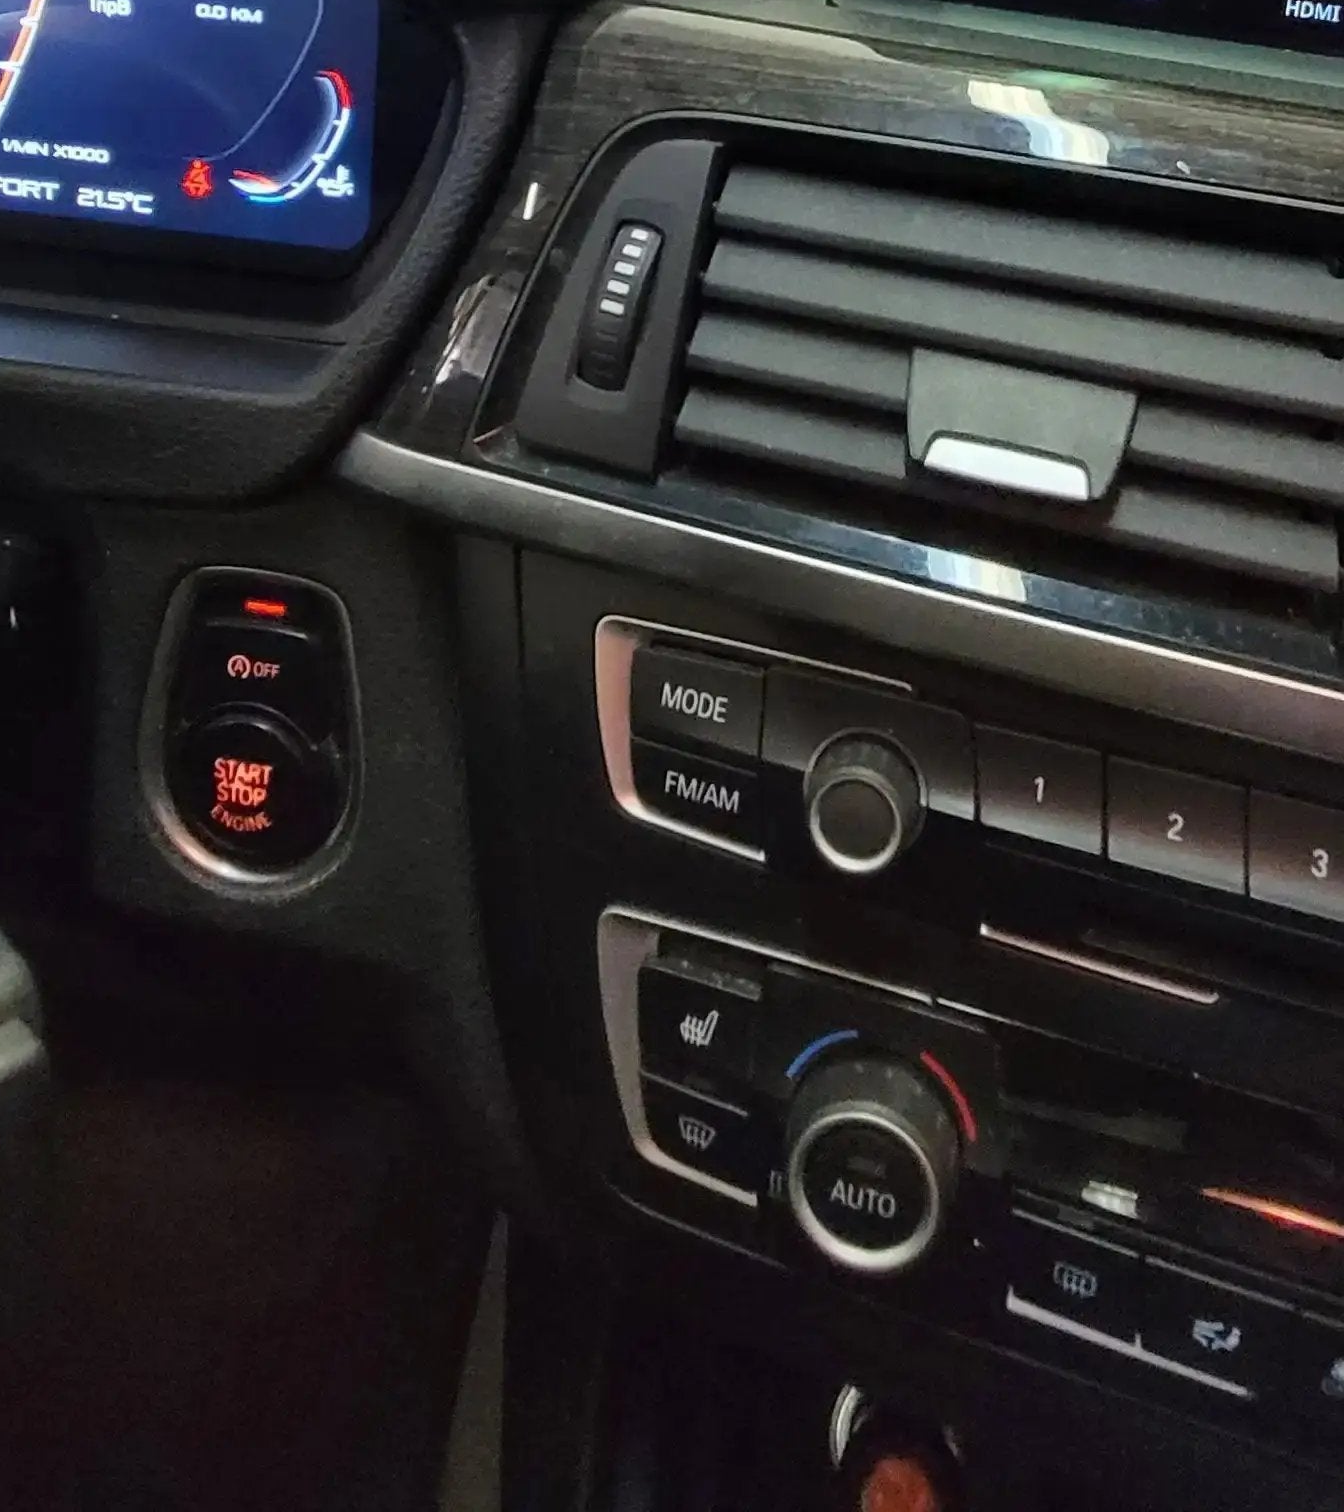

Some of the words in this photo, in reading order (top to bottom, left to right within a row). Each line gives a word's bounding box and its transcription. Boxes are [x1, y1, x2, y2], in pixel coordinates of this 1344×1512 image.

[230, 5, 264, 24] KM
[252, 661, 281, 679] OFF
[660, 681, 729, 724] MODE
[212, 757, 273, 784] START
[216, 781, 268, 807] STOP
[663, 769, 741, 815] FM/AM
[1033, 776, 1045, 803] 1
[210, 804, 272, 832] ENGINE
[1165, 813, 1185, 842] 2
[1309, 848, 1330, 880] 3
[829, 1177, 897, 1219] AUTO
